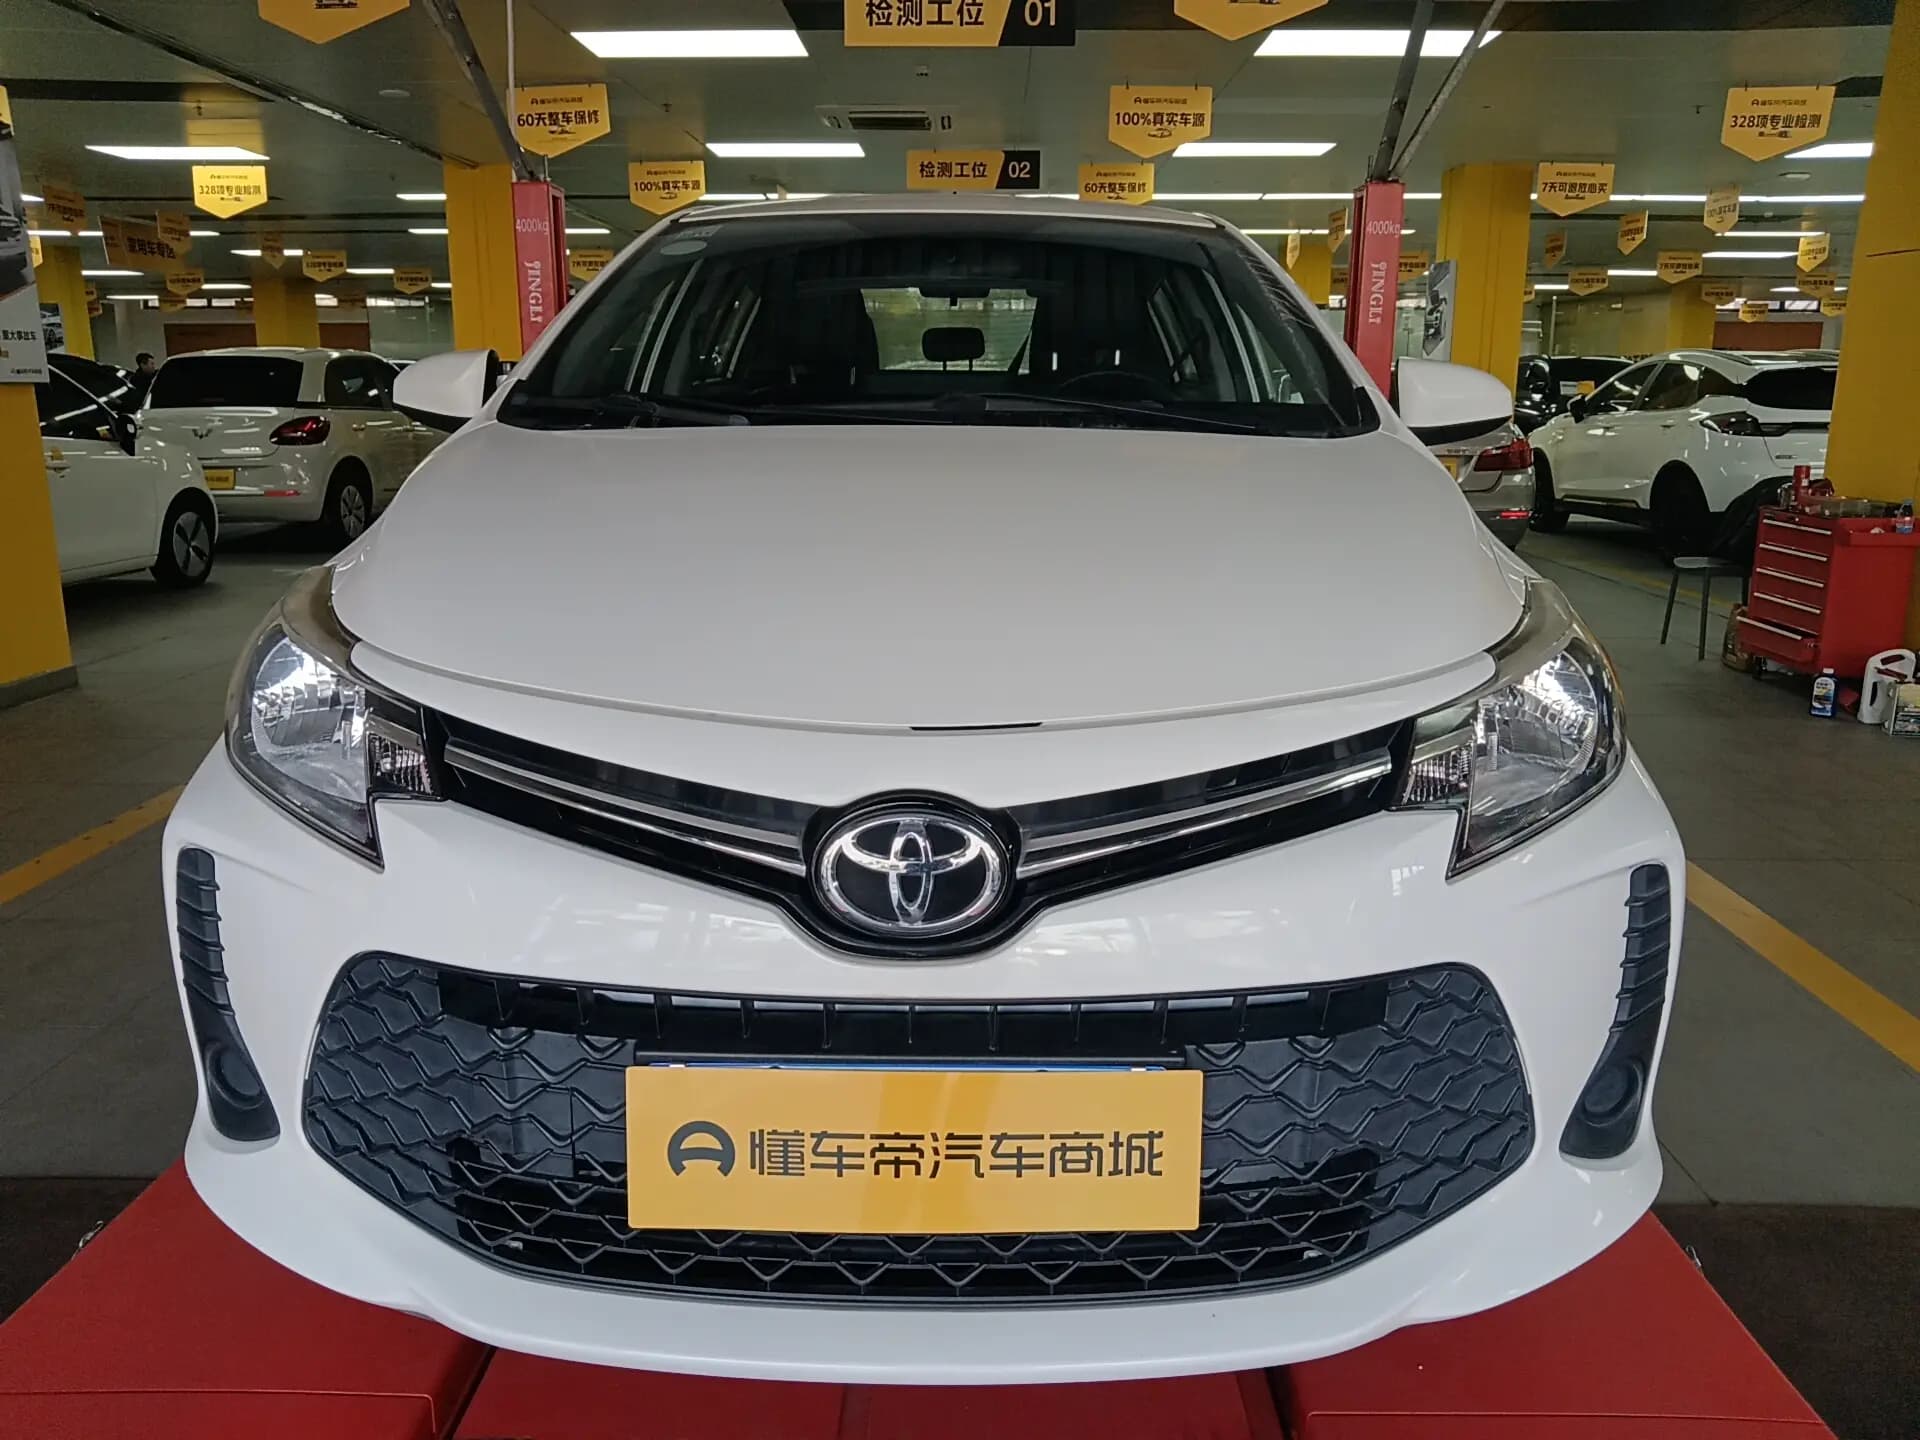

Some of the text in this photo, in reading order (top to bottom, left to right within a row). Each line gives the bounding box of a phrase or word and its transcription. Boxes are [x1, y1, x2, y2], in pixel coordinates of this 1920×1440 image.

[865, 0, 1056, 27] 检测工位 01
[517, 109, 600, 127] 60天整车保修
[1115, 111, 1206, 128] 100%真实车源
[1730, 113, 1822, 130] 328项专业检测
[920, 161, 1031, 178] 检测工位 02
[634, 180, 701, 193] 100%真实车源
[1541, 181, 1608, 194] 7天可退放心买
[515, 217, 549, 235] 4000kg
[1366, 220, 1401, 238] 4000kg
[749, 1128, 1165, 1179] 懂车帝汽车商城
